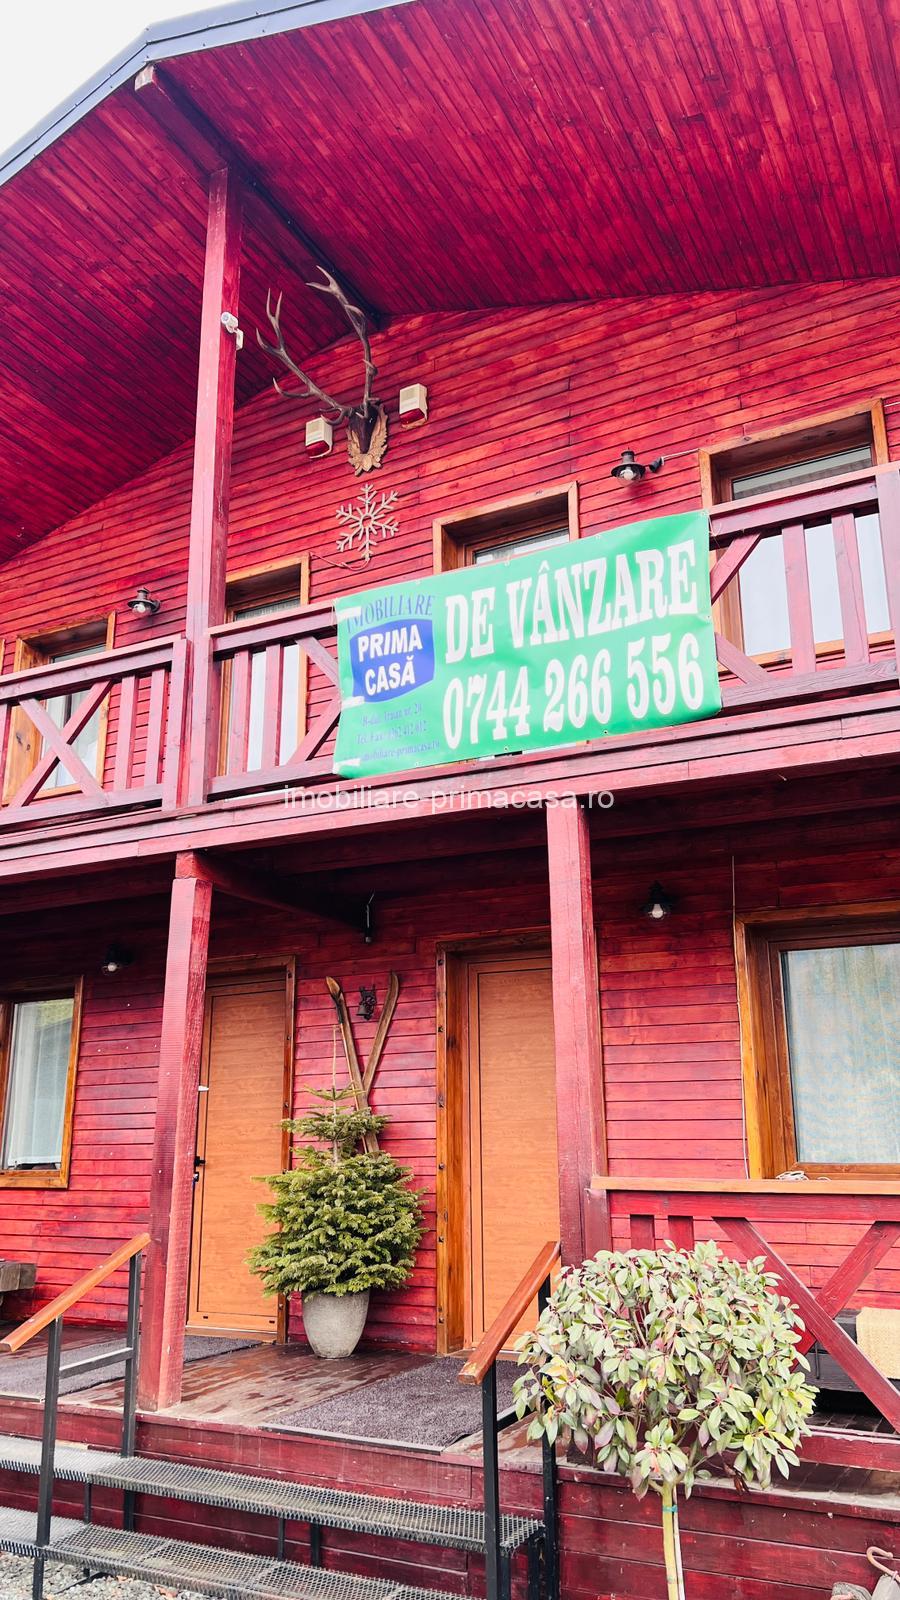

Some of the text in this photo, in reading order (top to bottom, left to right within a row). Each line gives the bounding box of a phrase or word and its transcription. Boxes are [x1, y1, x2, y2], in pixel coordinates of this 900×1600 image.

[444, 539, 698, 664] DE VÂNZARE
[357, 624, 423, 662] PRIMA
[364, 655, 416, 696] CASĂ
[442, 632, 704, 750] 0744 266 556
